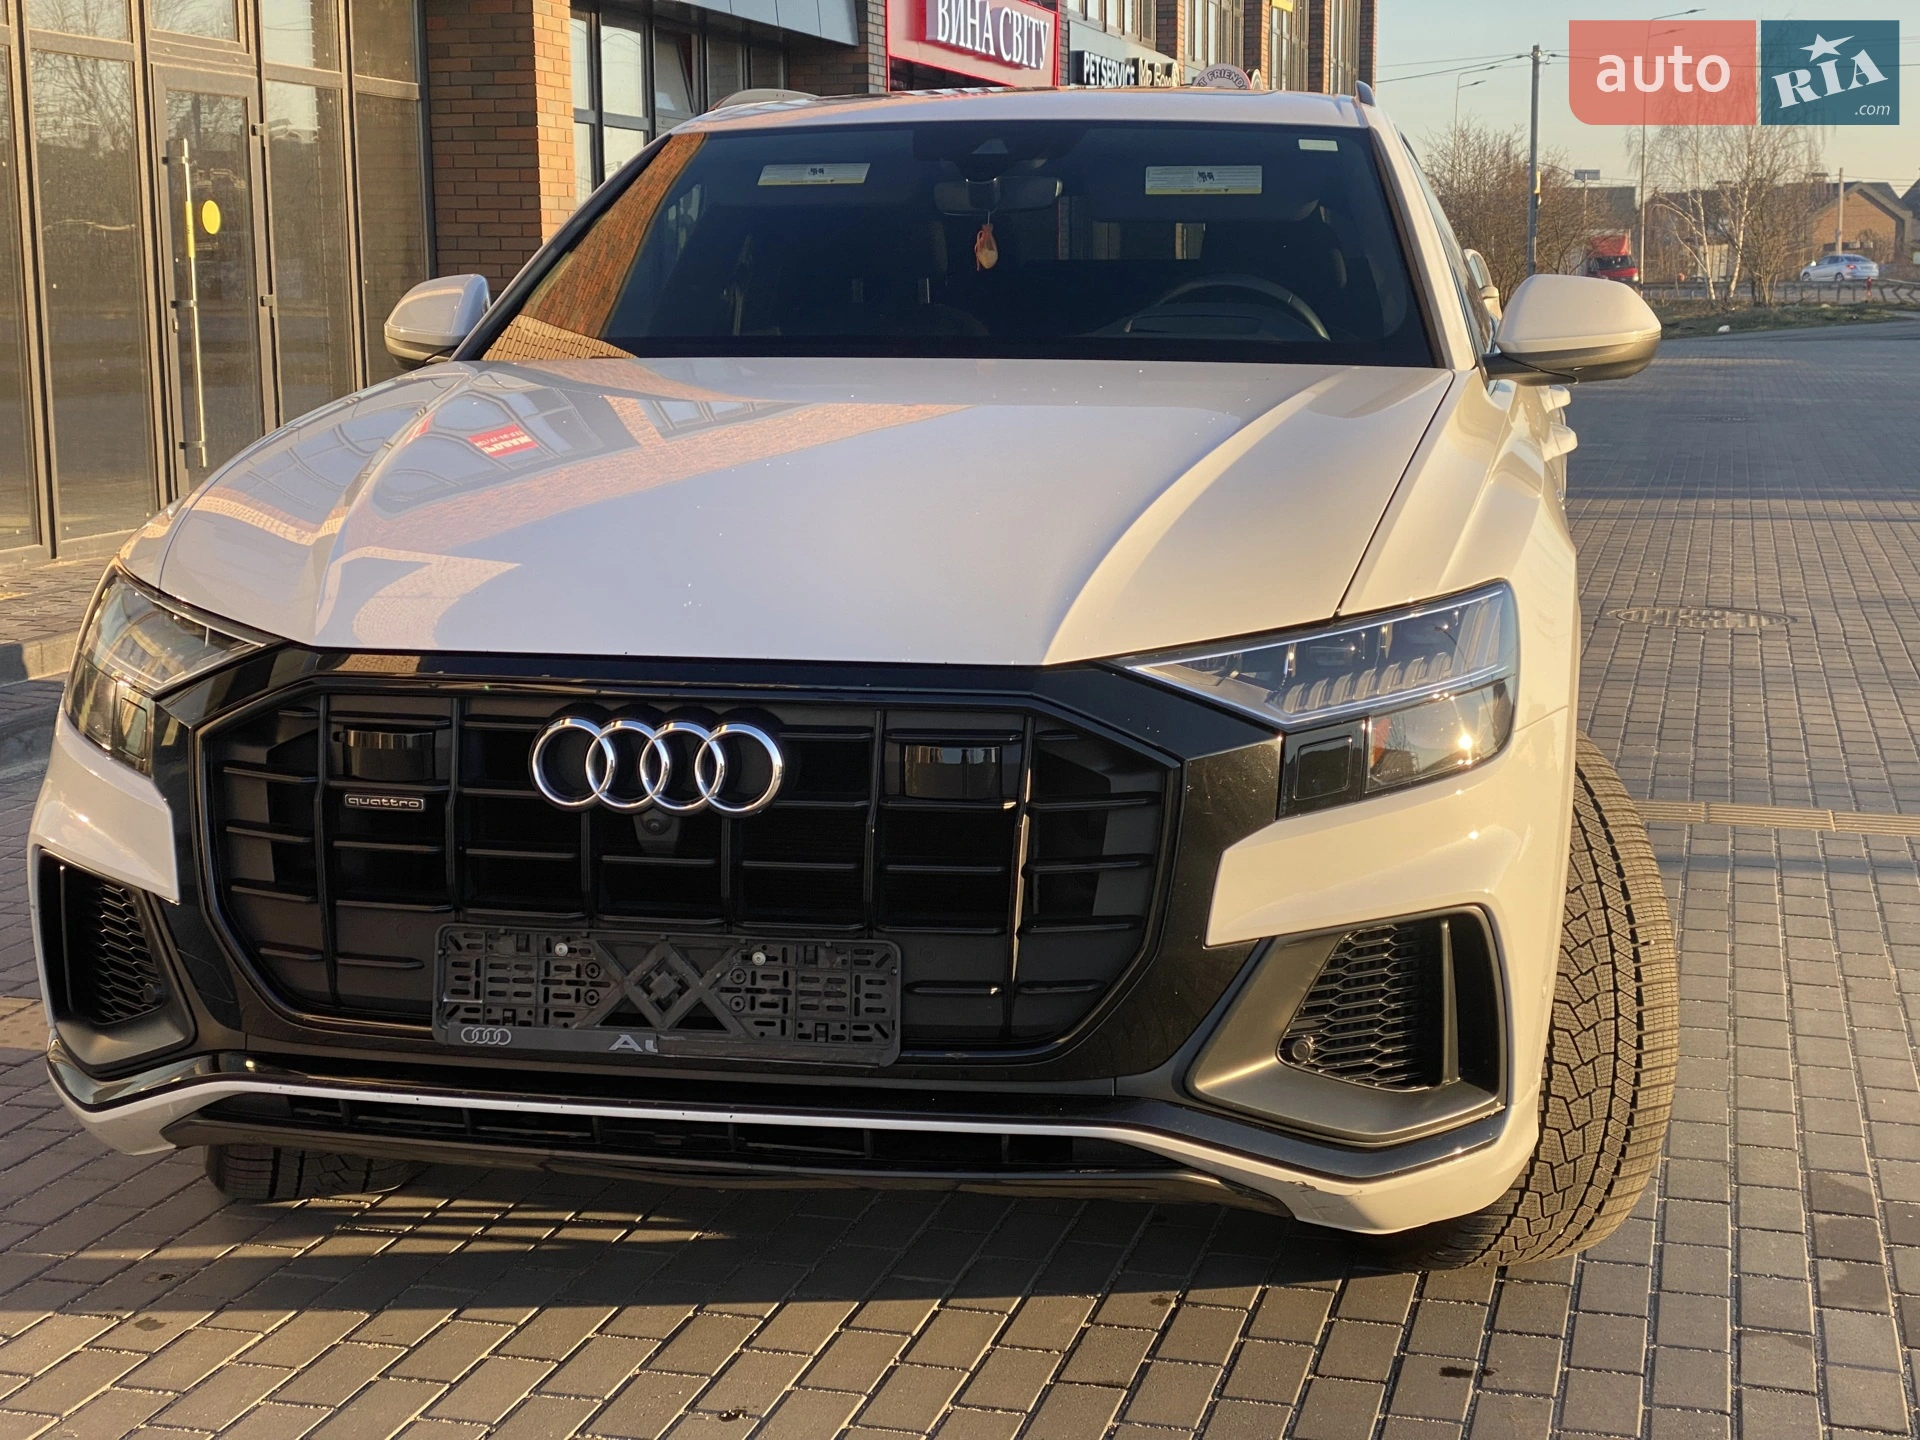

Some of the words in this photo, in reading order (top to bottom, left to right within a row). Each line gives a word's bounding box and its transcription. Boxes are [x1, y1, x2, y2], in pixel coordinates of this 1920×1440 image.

[937, 0, 996, 56] ВИНА
[999, 7, 1050, 70] СВІТУ
[1083, 51, 1101, 86] PET
[1101, 57, 1135, 87] SERVICE
[348, 797, 419, 808] quattro
